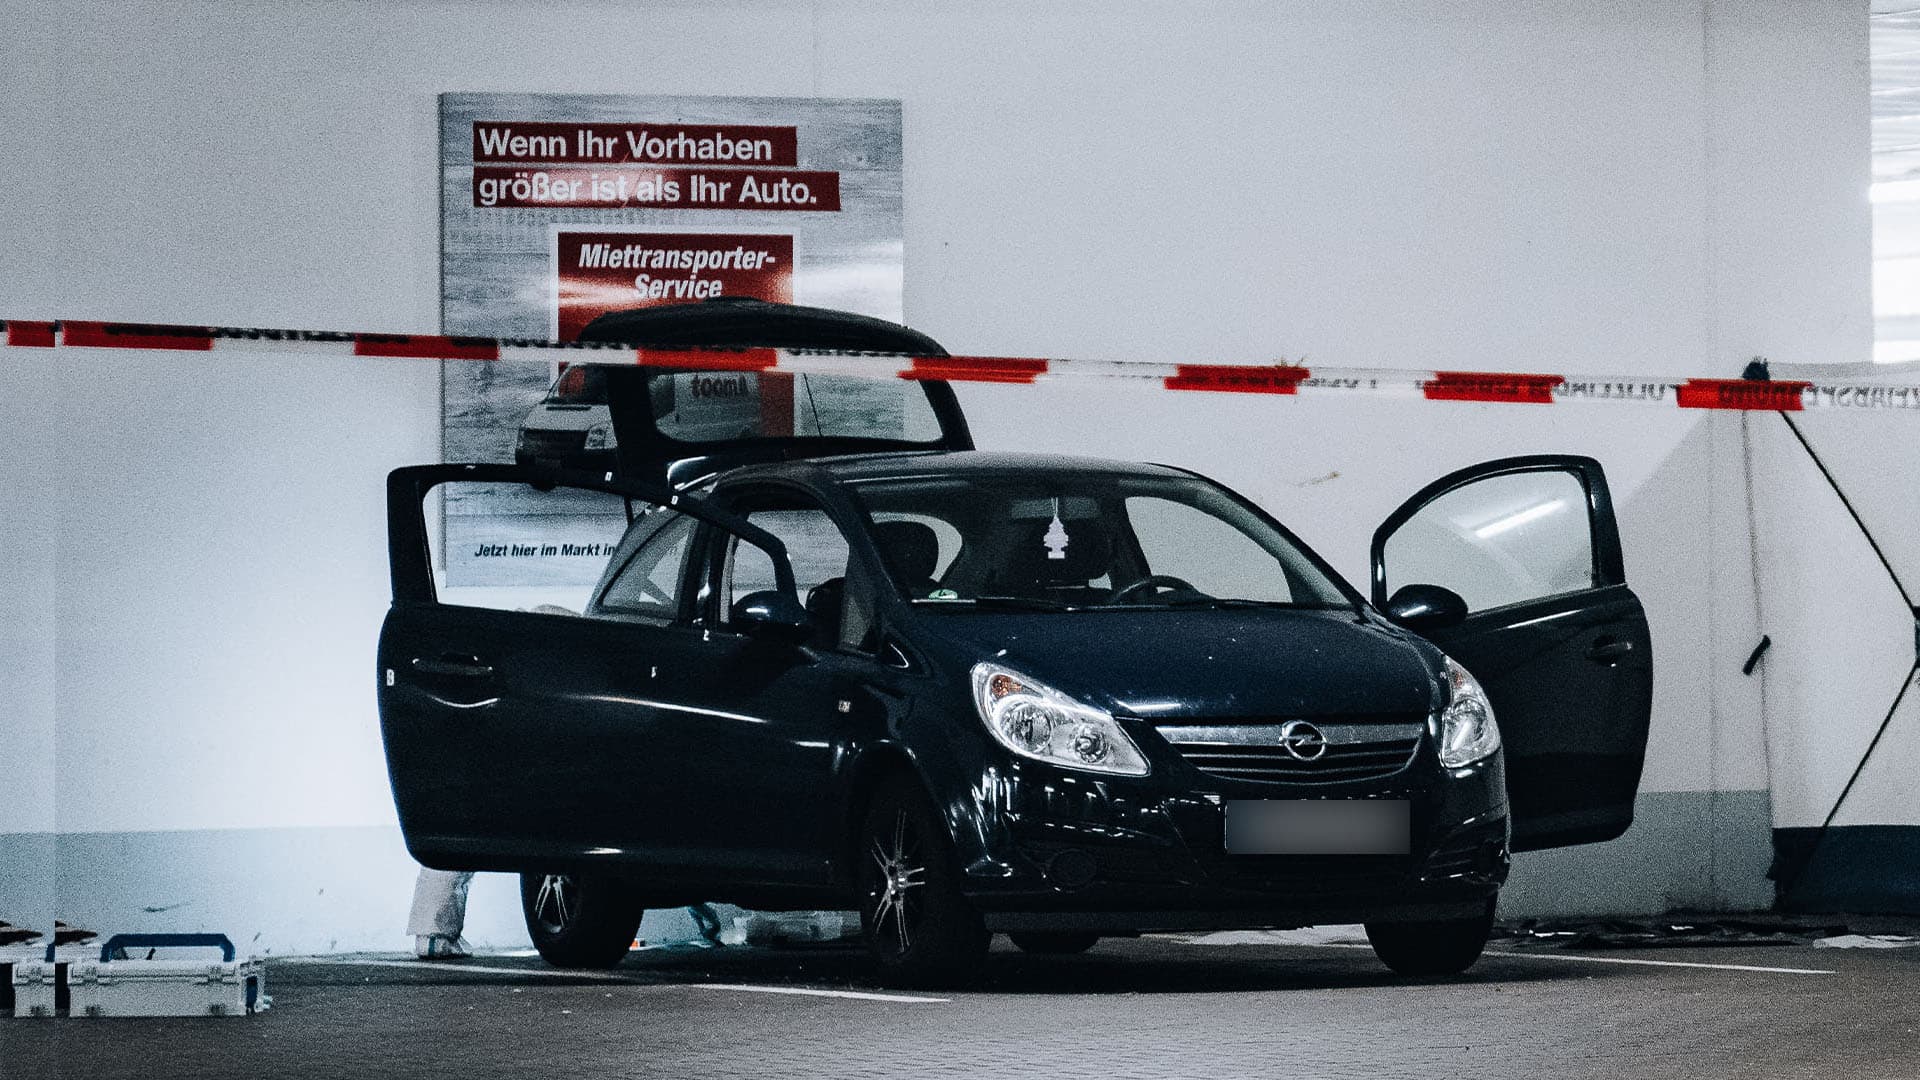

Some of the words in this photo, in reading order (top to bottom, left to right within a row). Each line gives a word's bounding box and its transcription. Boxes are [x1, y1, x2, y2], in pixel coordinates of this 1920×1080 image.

[479, 127, 567, 159] Wenn
[577, 129, 618, 160] Ihr
[626, 130, 772, 161] Vorhaben
[479, 172, 580, 206] größer
[590, 175, 629, 202] ist
[636, 174, 681, 204] als
[690, 175, 730, 204] Ihr
[738, 176, 818, 205] Auto.
[578, 243, 776, 273] Miettransporter-
[634, 273, 722, 299] Service
[475, 543, 508, 558] Jetzt
[511, 544, 537, 557] hier
[540, 544, 557, 557] im
[561, 543, 600, 556] Markt
